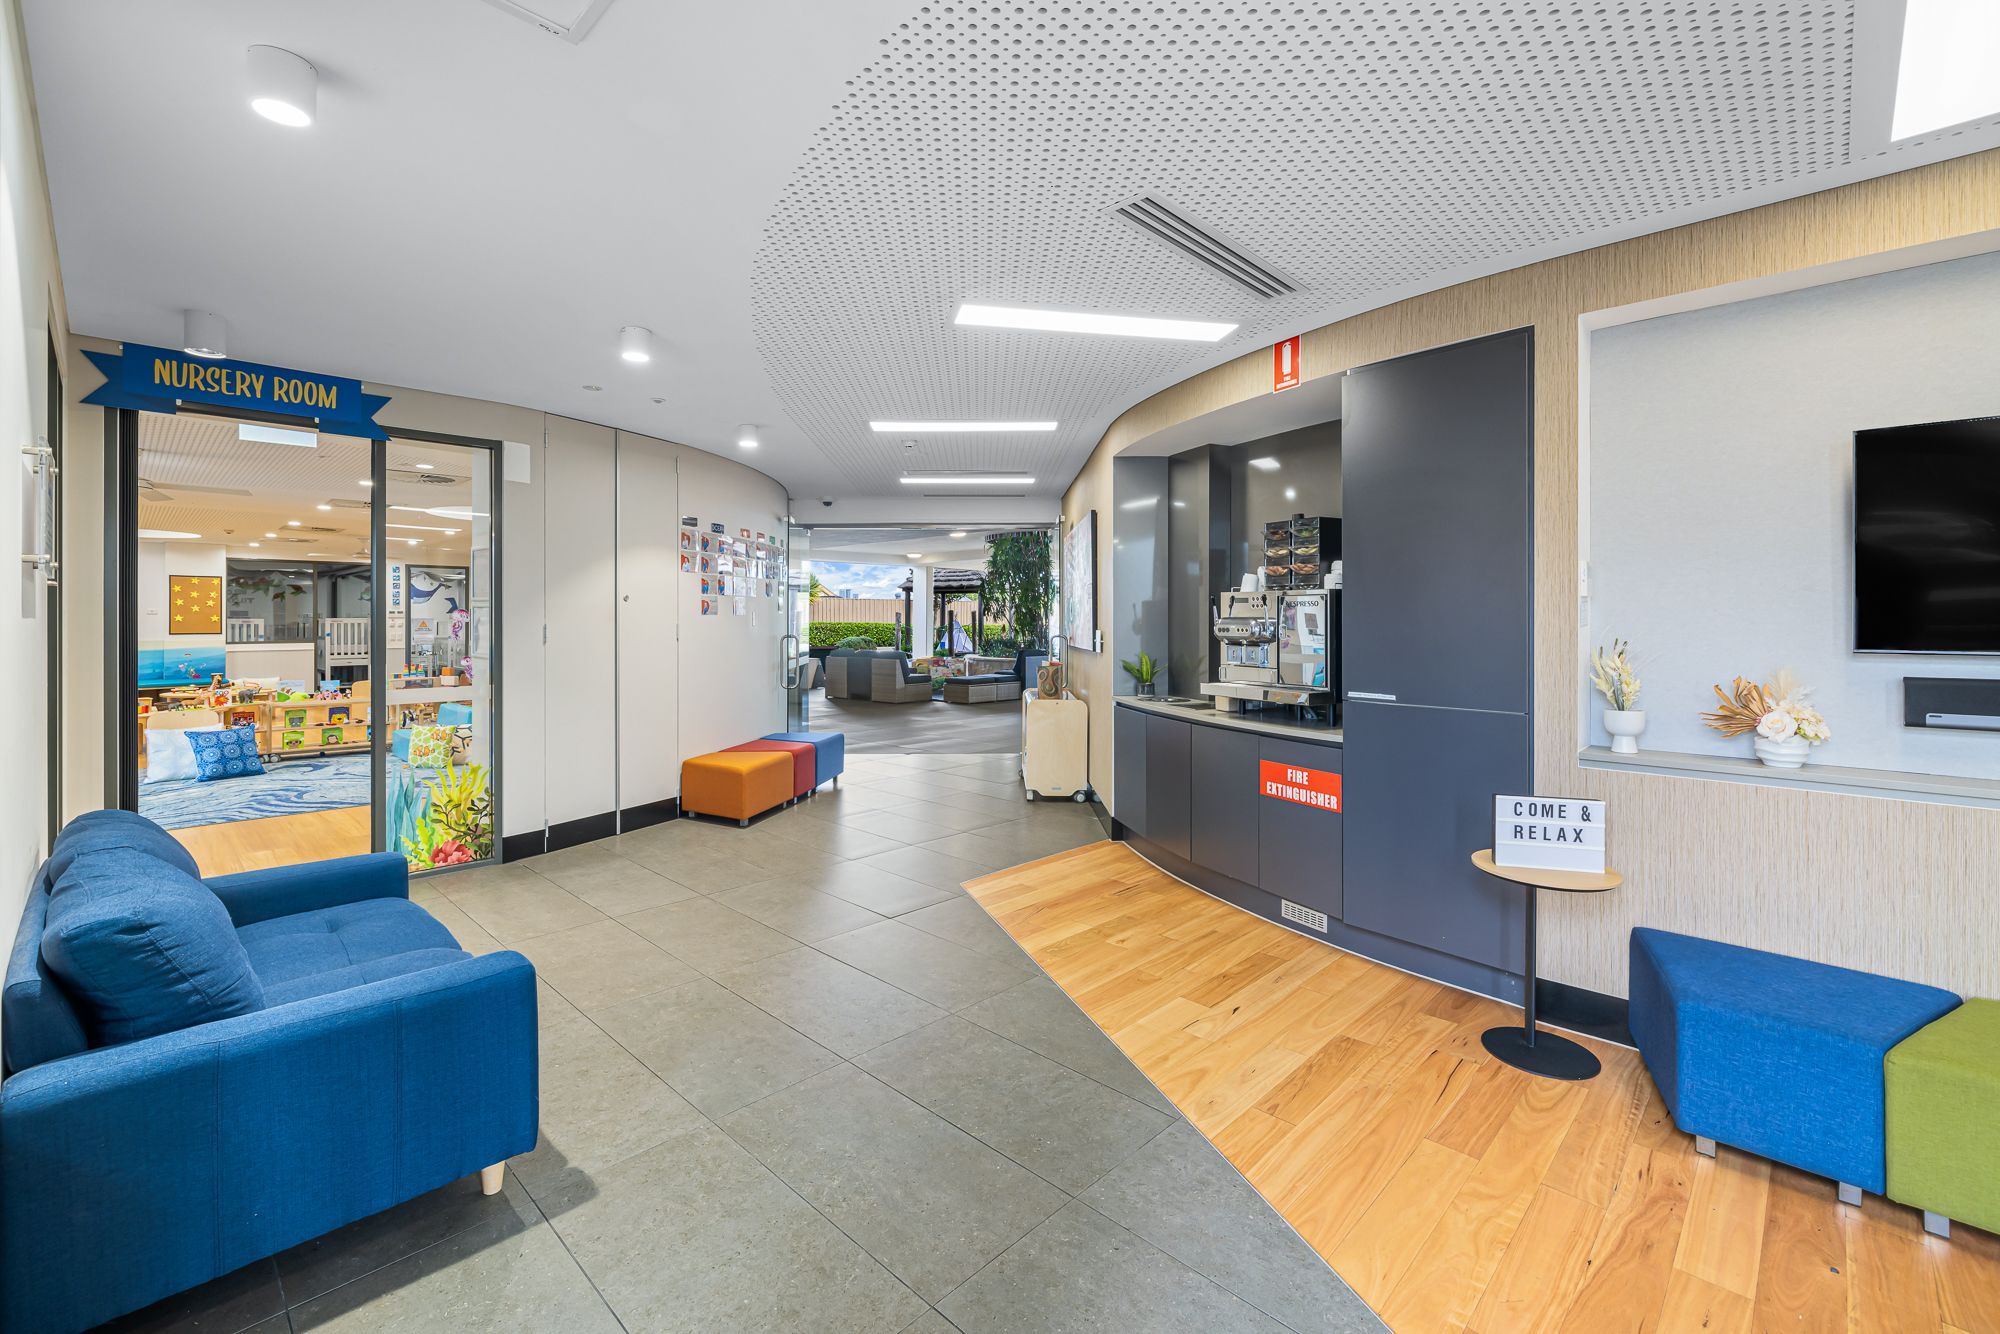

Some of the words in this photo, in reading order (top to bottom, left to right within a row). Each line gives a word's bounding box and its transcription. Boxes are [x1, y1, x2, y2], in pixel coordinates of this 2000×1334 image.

[154, 358, 264, 398] NURSERY
[274, 376, 337, 409] ROOM
[1287, 768, 1309, 785] FIRE
[1266, 781, 1338, 809] EXTINGUISHER
[1514, 801, 1567, 818] COME
[1581, 805, 1592, 822] &
[1514, 825, 1583, 843] RELAX
